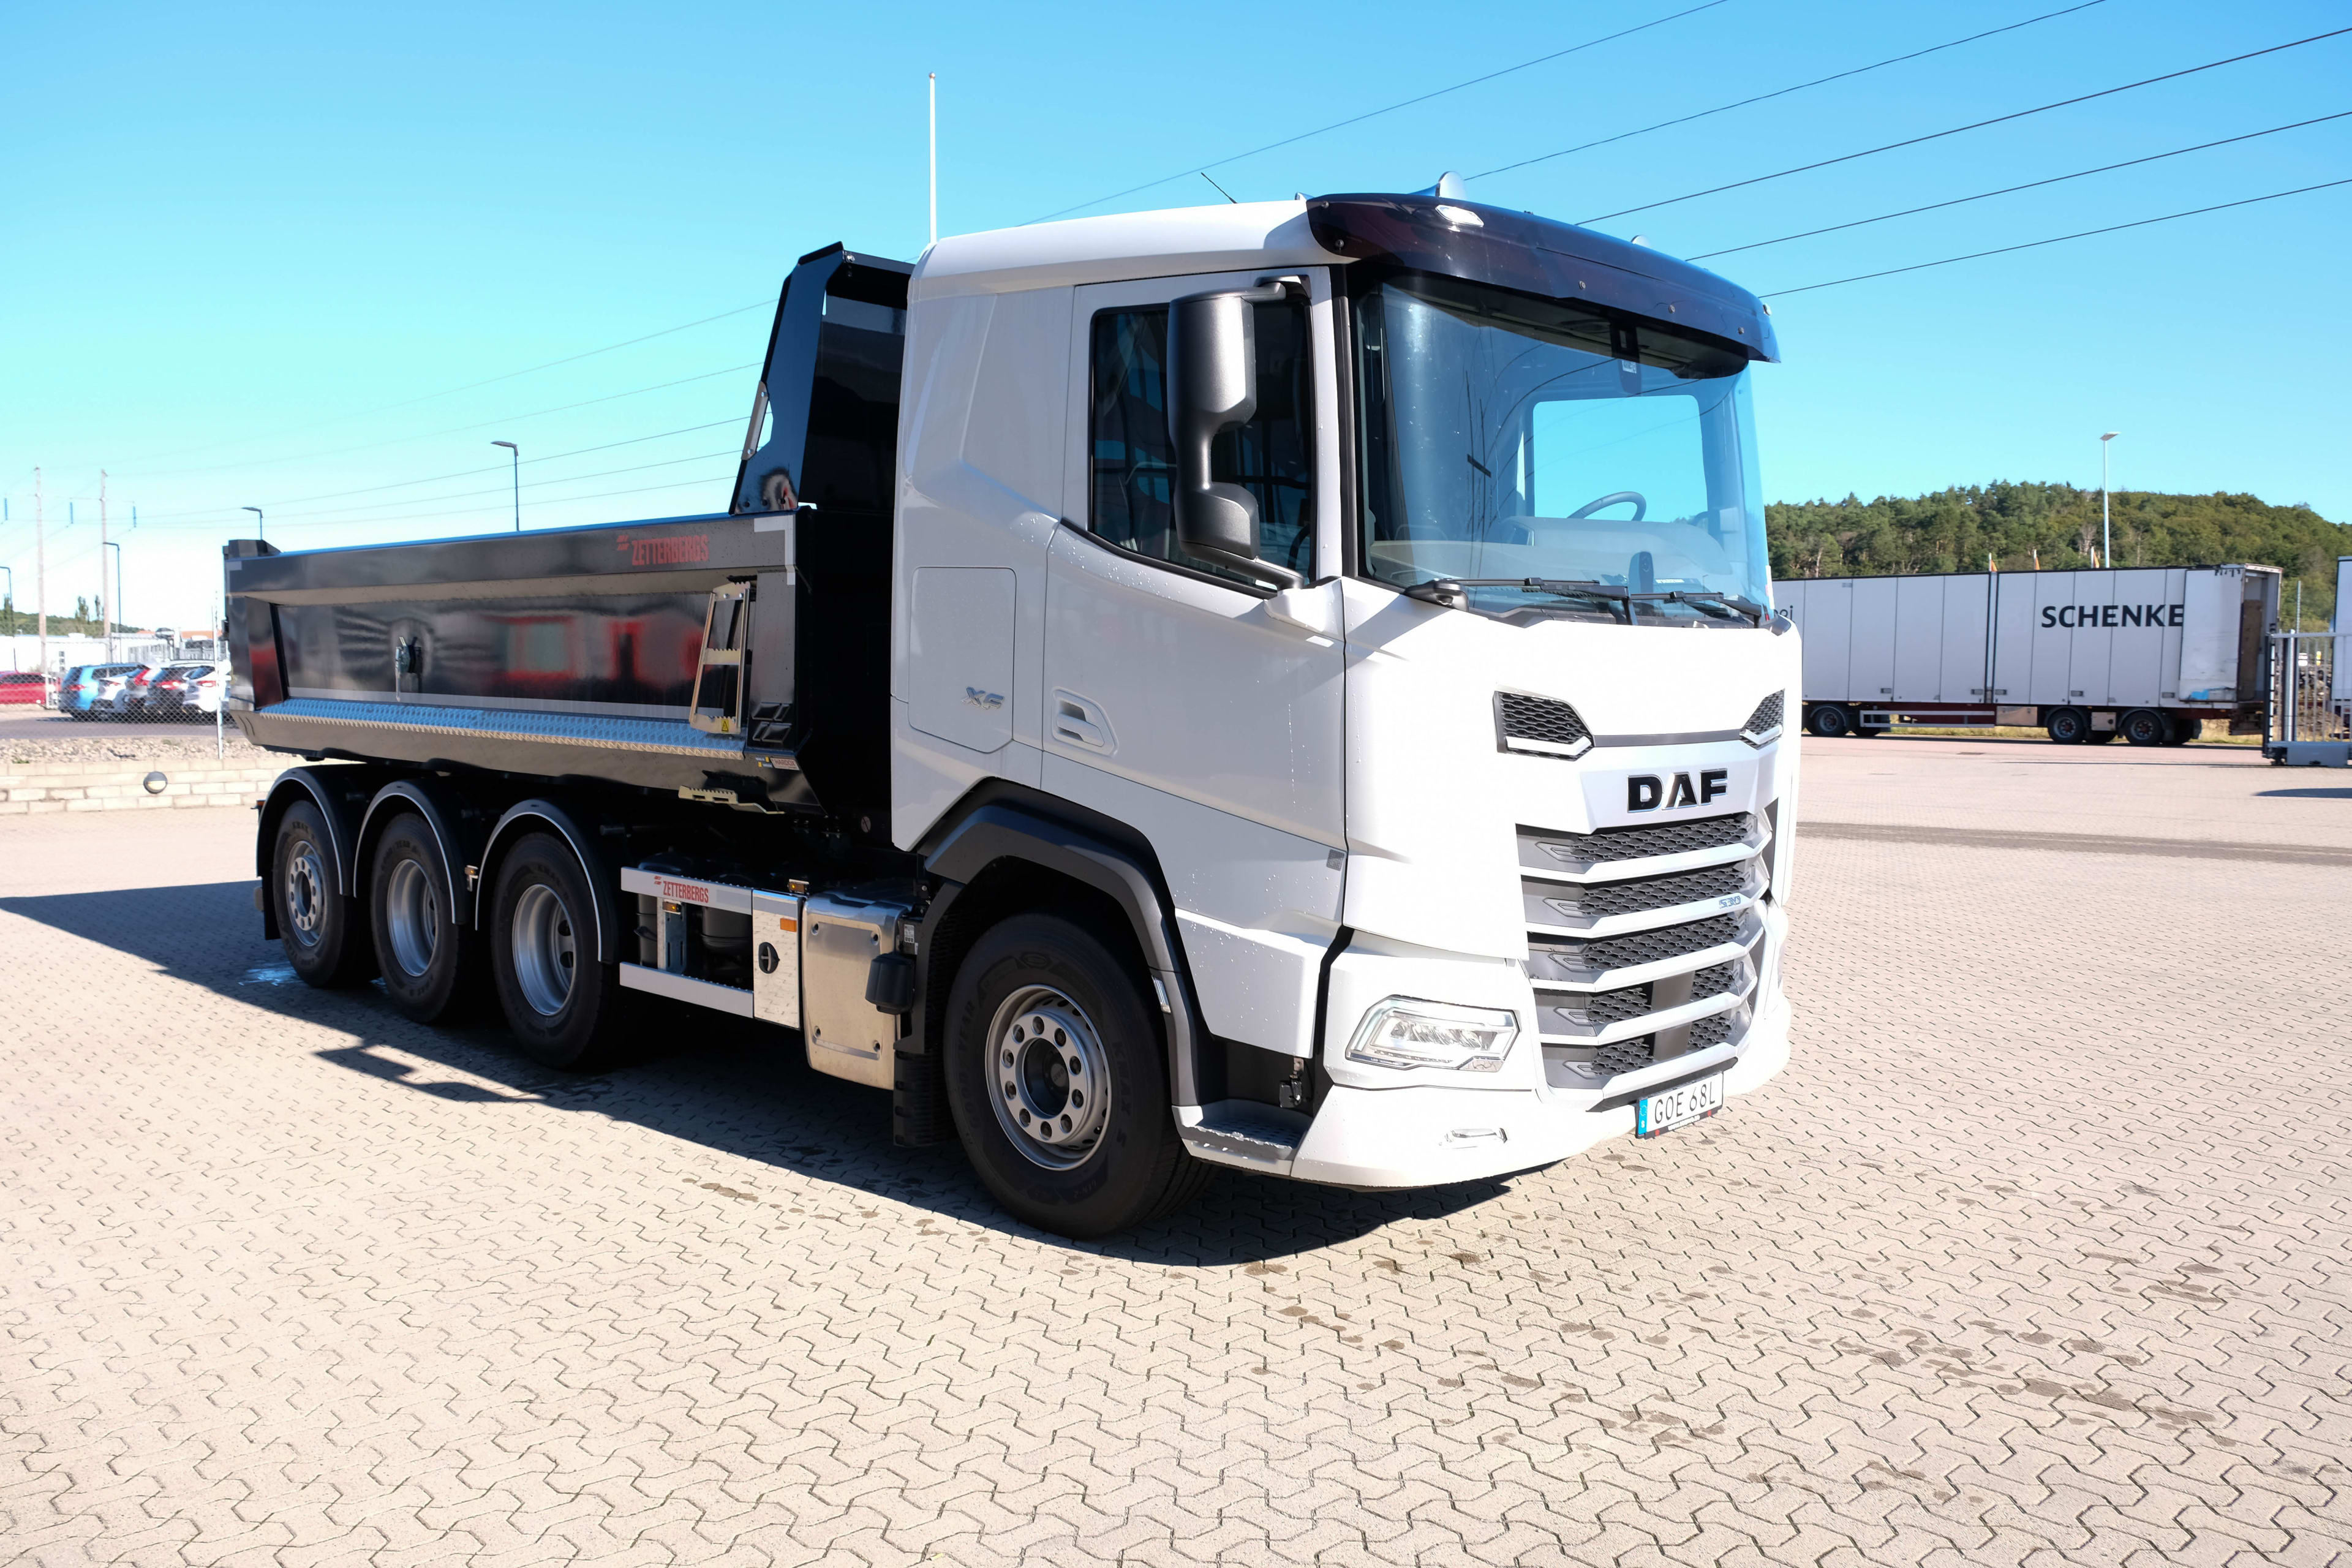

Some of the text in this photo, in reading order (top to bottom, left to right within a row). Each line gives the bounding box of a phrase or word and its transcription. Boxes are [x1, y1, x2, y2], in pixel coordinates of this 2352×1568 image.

[631, 534, 709, 565] ZETTERBERGS
[2041, 605, 2184, 628] SCHENKE
[960, 686, 1005, 710] XF
[1627, 768, 1728, 813] DAF
[663, 881, 709, 903] ZETTERBERGS
[1654, 1091, 1684, 1124] GOE
[1689, 1081, 1715, 1112] 68L
